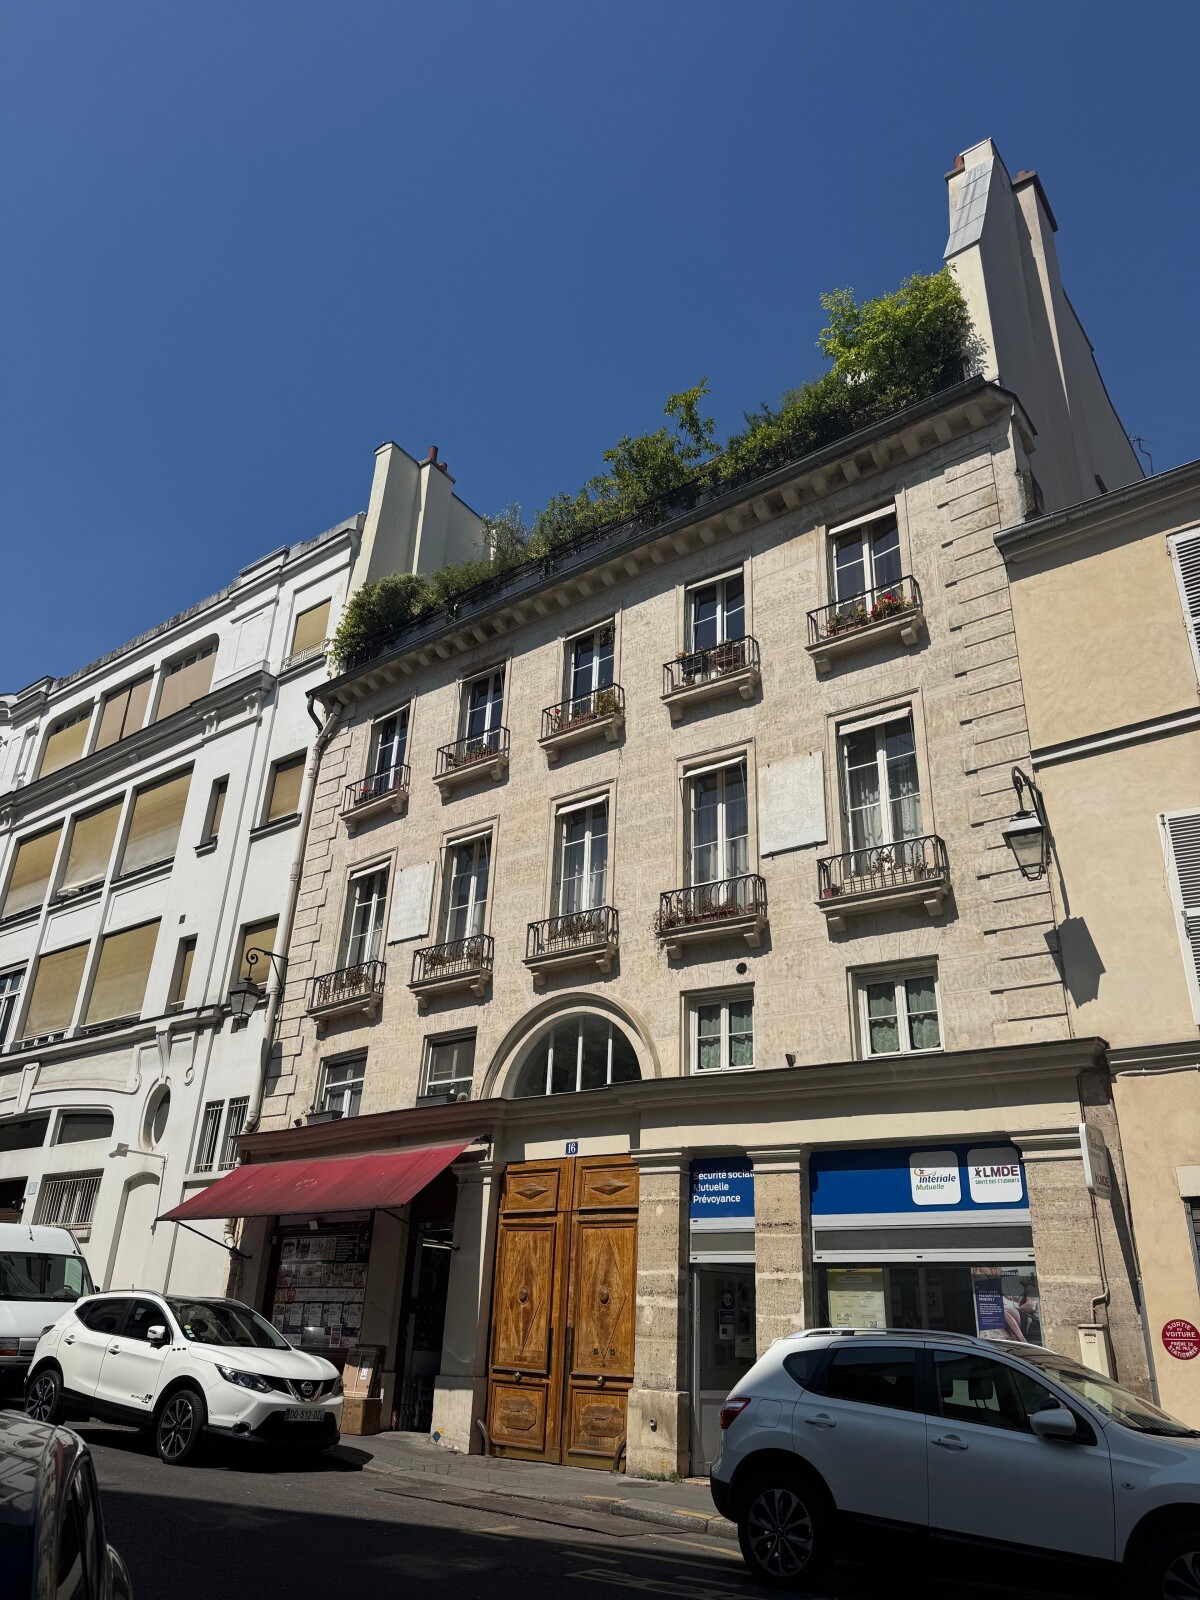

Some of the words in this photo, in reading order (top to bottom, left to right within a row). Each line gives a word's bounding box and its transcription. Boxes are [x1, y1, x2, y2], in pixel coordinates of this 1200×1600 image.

[568, 1142, 576, 1154] 16
[693, 1170, 727, 1180] Sécurité
[983, 1165, 1019, 1178] LMDE
[693, 1182, 730, 1192] Mutuelle
[693, 1194, 741, 1204] Prévoyance
[1167, 1321, 1192, 1331] SORTIE
[1167, 1345, 1199, 1358] STATIONNER
